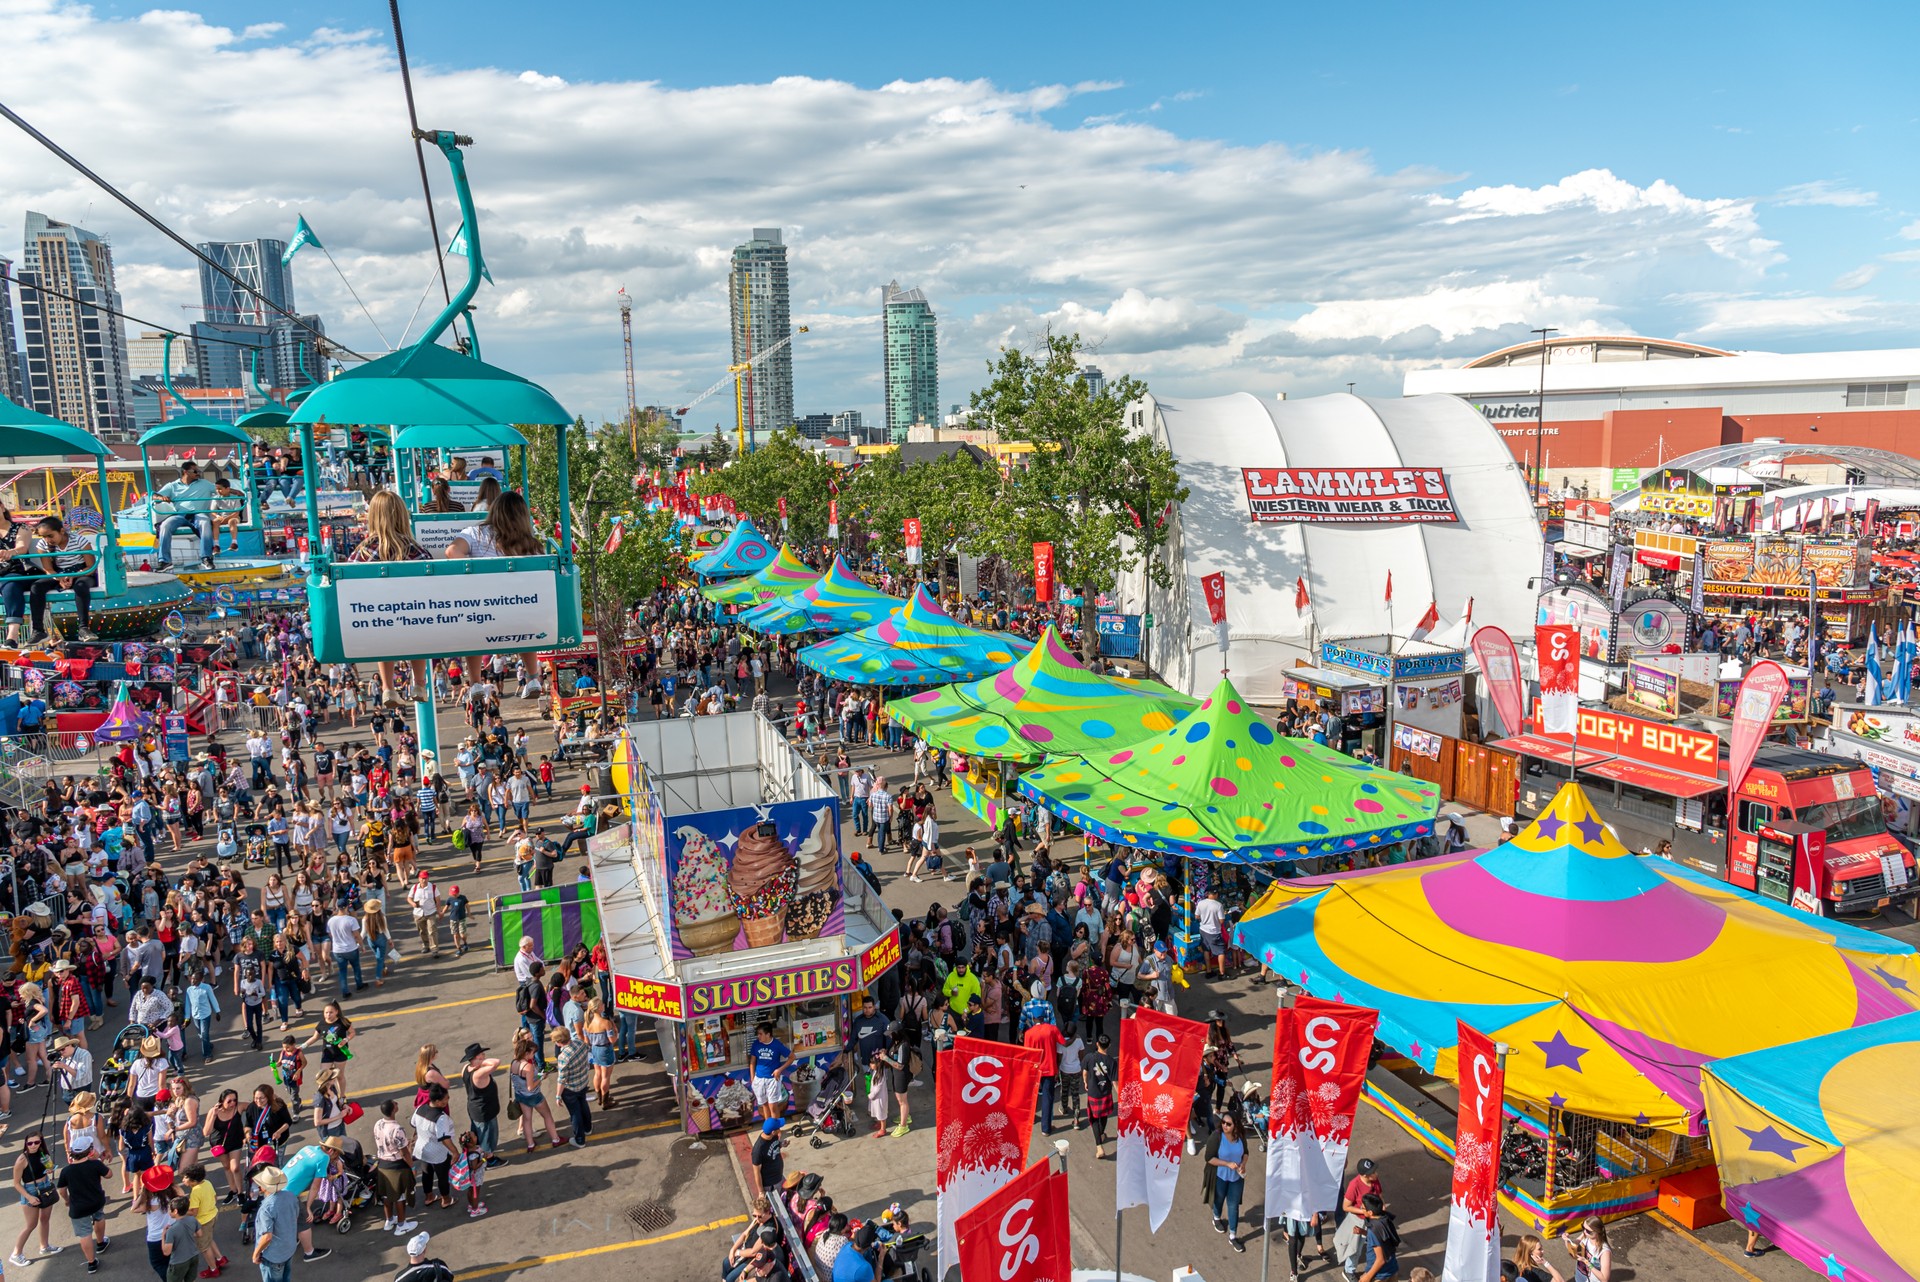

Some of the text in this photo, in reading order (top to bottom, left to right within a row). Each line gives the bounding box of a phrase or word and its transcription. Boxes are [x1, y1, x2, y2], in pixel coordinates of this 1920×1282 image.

[1248, 470, 1444, 497] LAMMLE'S
[1252, 498, 1451, 513] WESTERN WEAR & TACK
[421, 527, 450, 535] Relaxing,
[1731, 545, 1750, 553] FRIES
[1757, 545, 1774, 556] FRY
[1775, 545, 1799, 557] GUYS
[1210, 578, 1224, 599] CS
[1703, 584, 1763, 595] FRESH CUT FRIES
[1784, 588, 1829, 599] POUTNE
[350, 593, 538, 614] The captain has now switched
[352, 619, 370, 628] on
[372, 616, 394, 627] the
[466, 611, 496, 624] sign.
[485, 633, 535, 643] WESTJET
[559, 635, 575, 645] 36
[1551, 632, 1569, 661] CS
[1328, 647, 1388, 668] PORTRAITS
[1398, 656, 1462, 670] PORTRAITS
[1536, 704, 1714, 763] POGY BOYZ
[870, 936, 891, 961] HOT
[863, 944, 900, 982] CHOCOLATE
[629, 979, 666, 998] HOT
[692, 964, 852, 1014] SLUSHIES
[617, 992, 681, 1016] CHOCOLATE
[1298, 1016, 1341, 1074] CS
[1139, 1028, 1176, 1085] CS
[961, 1056, 1004, 1105] CS
[999, 1198, 1040, 1281] CS
